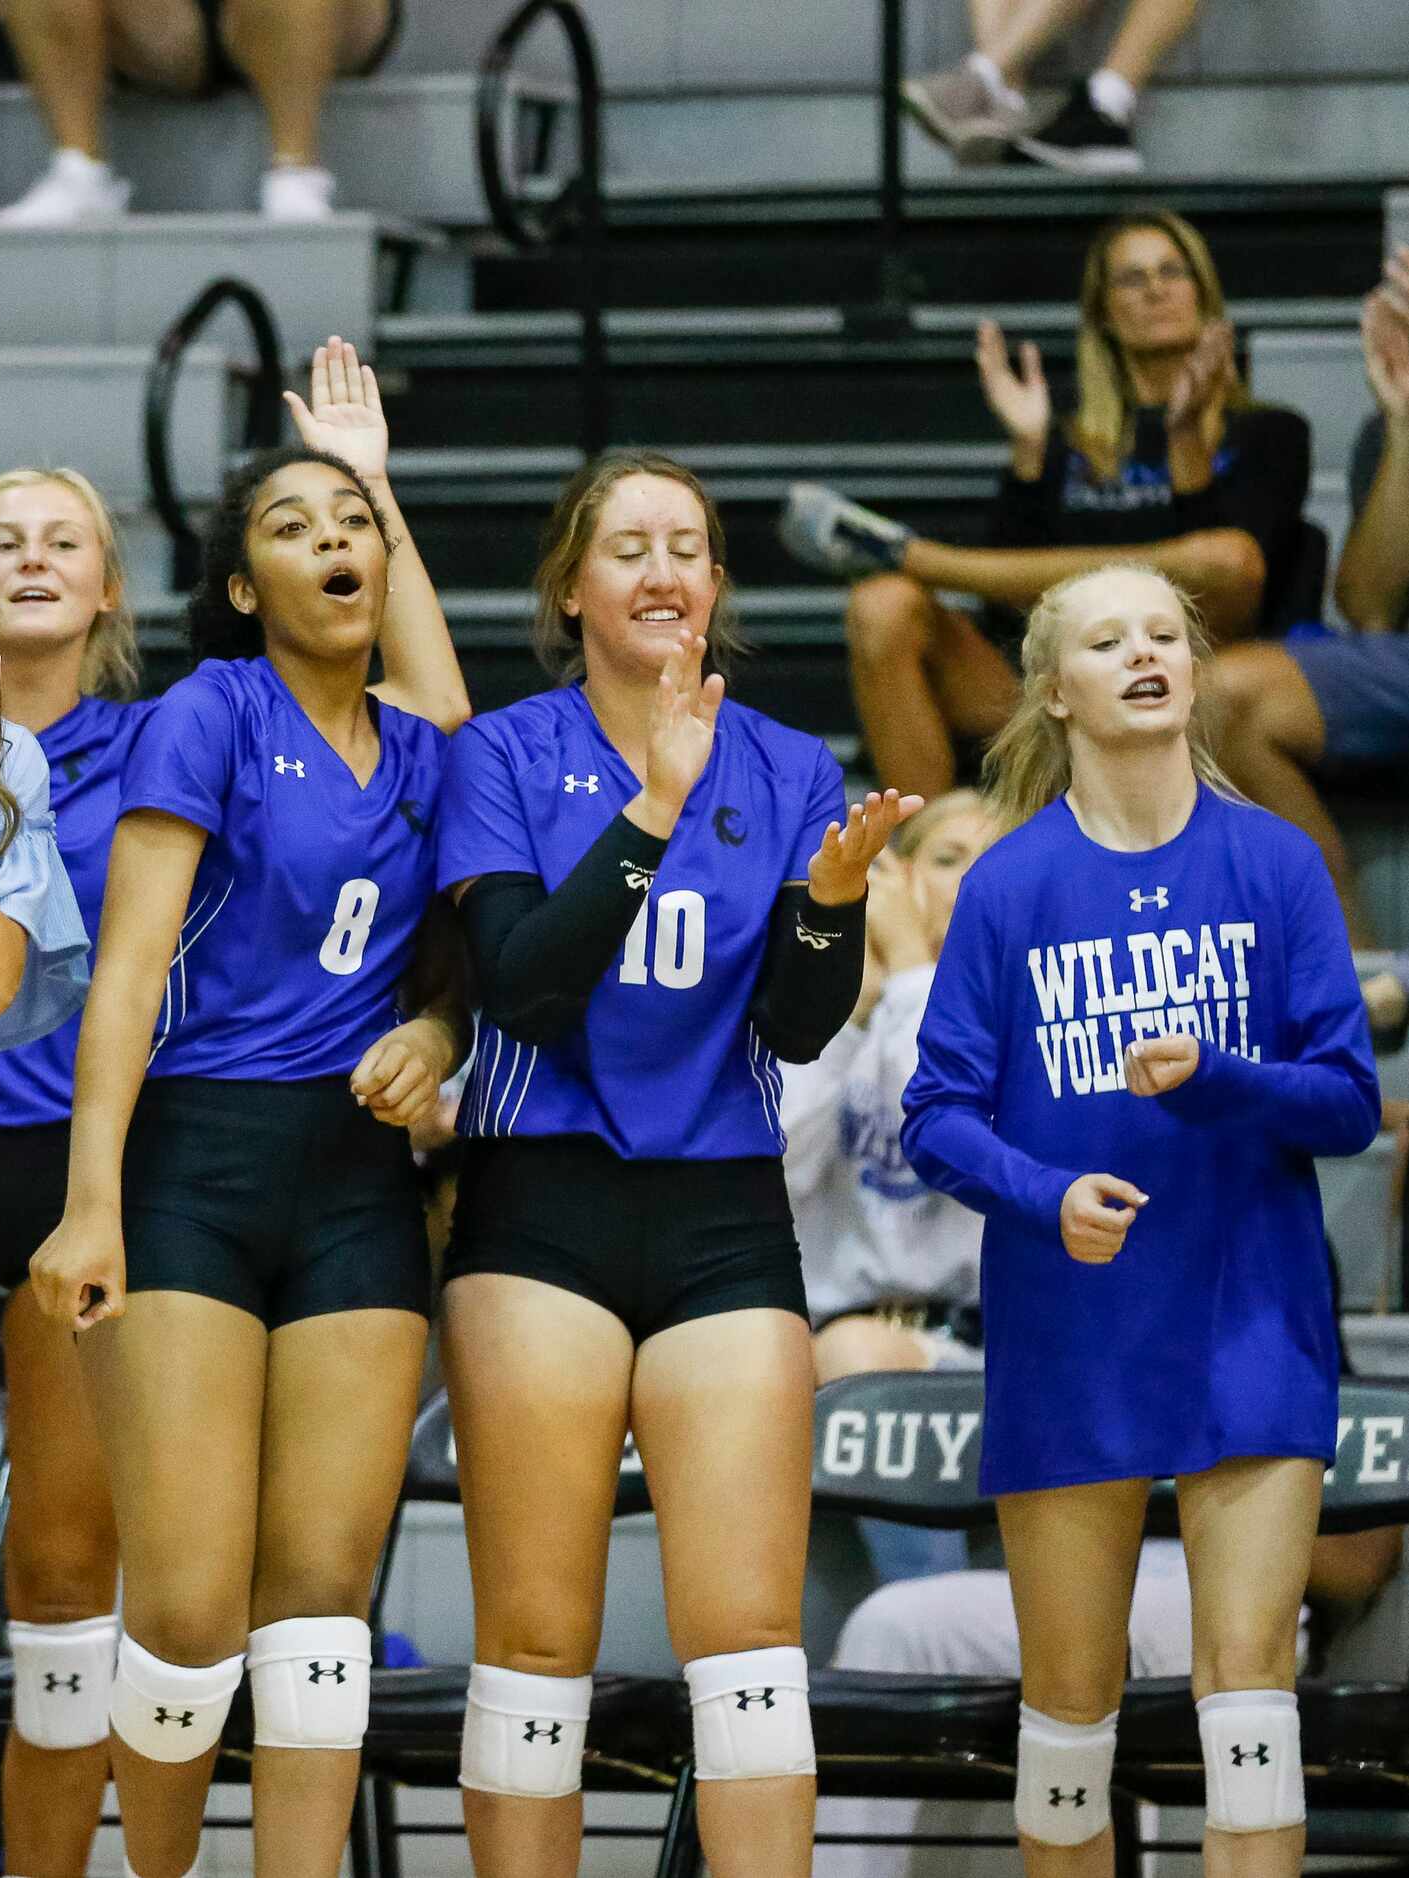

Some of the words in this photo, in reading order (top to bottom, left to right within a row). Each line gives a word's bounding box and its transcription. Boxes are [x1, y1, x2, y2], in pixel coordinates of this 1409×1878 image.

[319, 878, 380, 975] 8
[619, 889, 705, 989] 10
[1027, 921, 1256, 1023] WILDCAT
